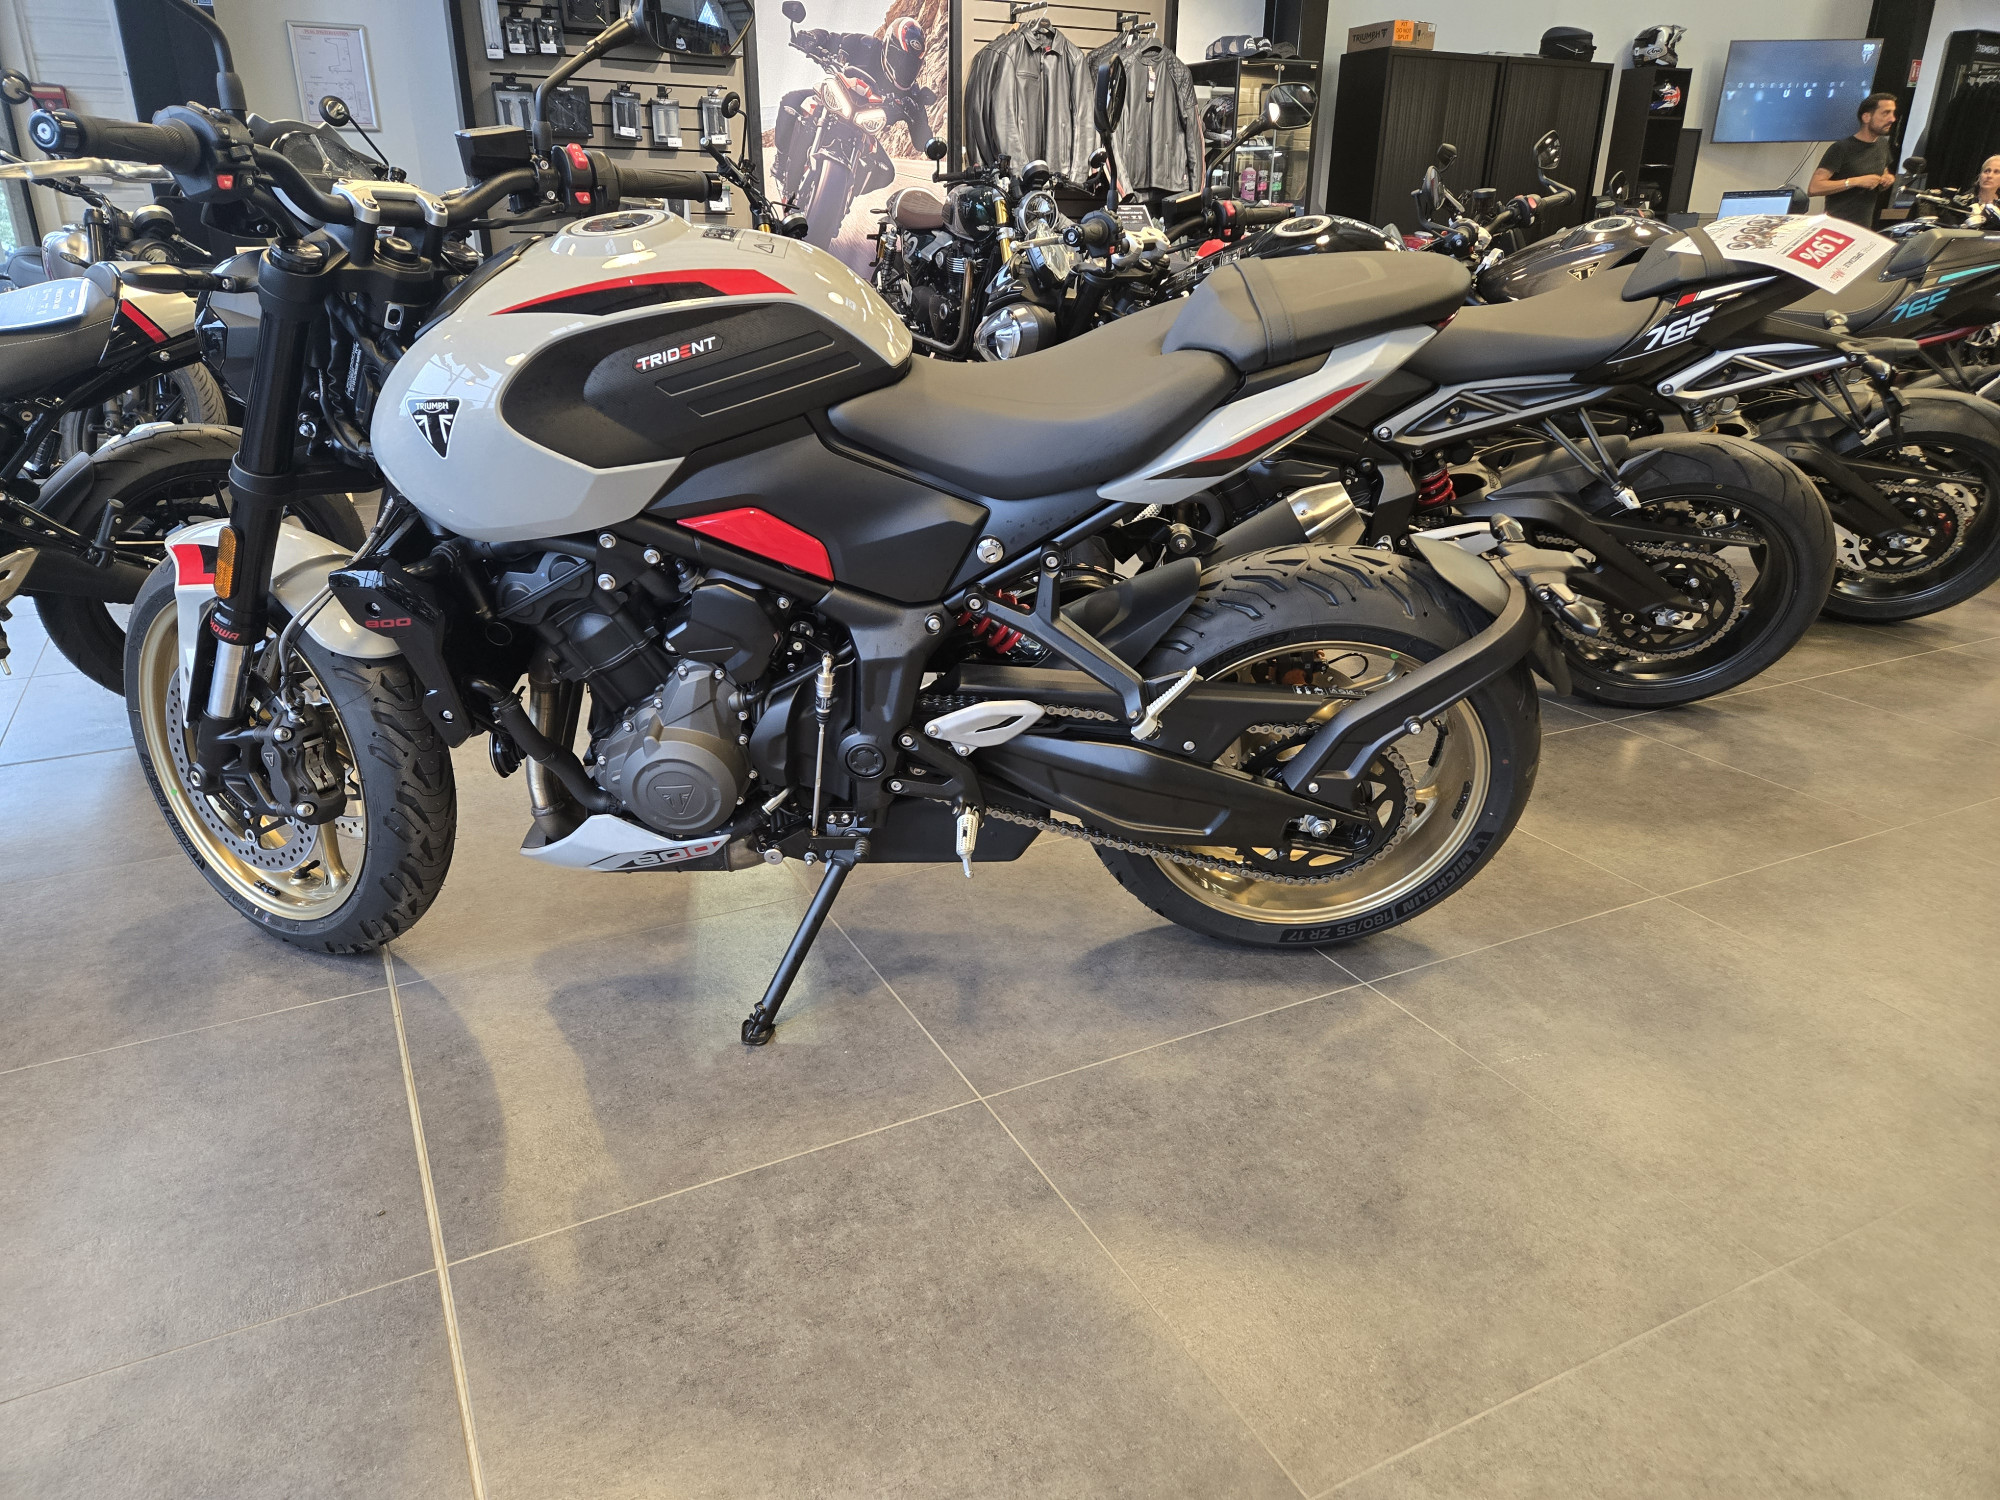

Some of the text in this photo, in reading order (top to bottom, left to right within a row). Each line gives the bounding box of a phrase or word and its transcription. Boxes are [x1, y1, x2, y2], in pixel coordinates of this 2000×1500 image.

[1352, 30, 1380, 43] TRIUMPH
[1799, 234, 1845, 263] 1,9%
[1891, 288, 1951, 323] 765
[1643, 306, 1715, 351] 765
[635, 336, 716, 370] TRIDENT
[415, 402, 449, 412] TRIUMPH
[210, 619, 240, 640] HOWA
[365, 618, 411, 628] 800
[167, 813, 197, 856] MICHELIN
[633, 843, 716, 867] 800
[1402, 852, 1474, 913] MICHELIN
[1286, 911, 1392, 941] 180/55 ZR 17
